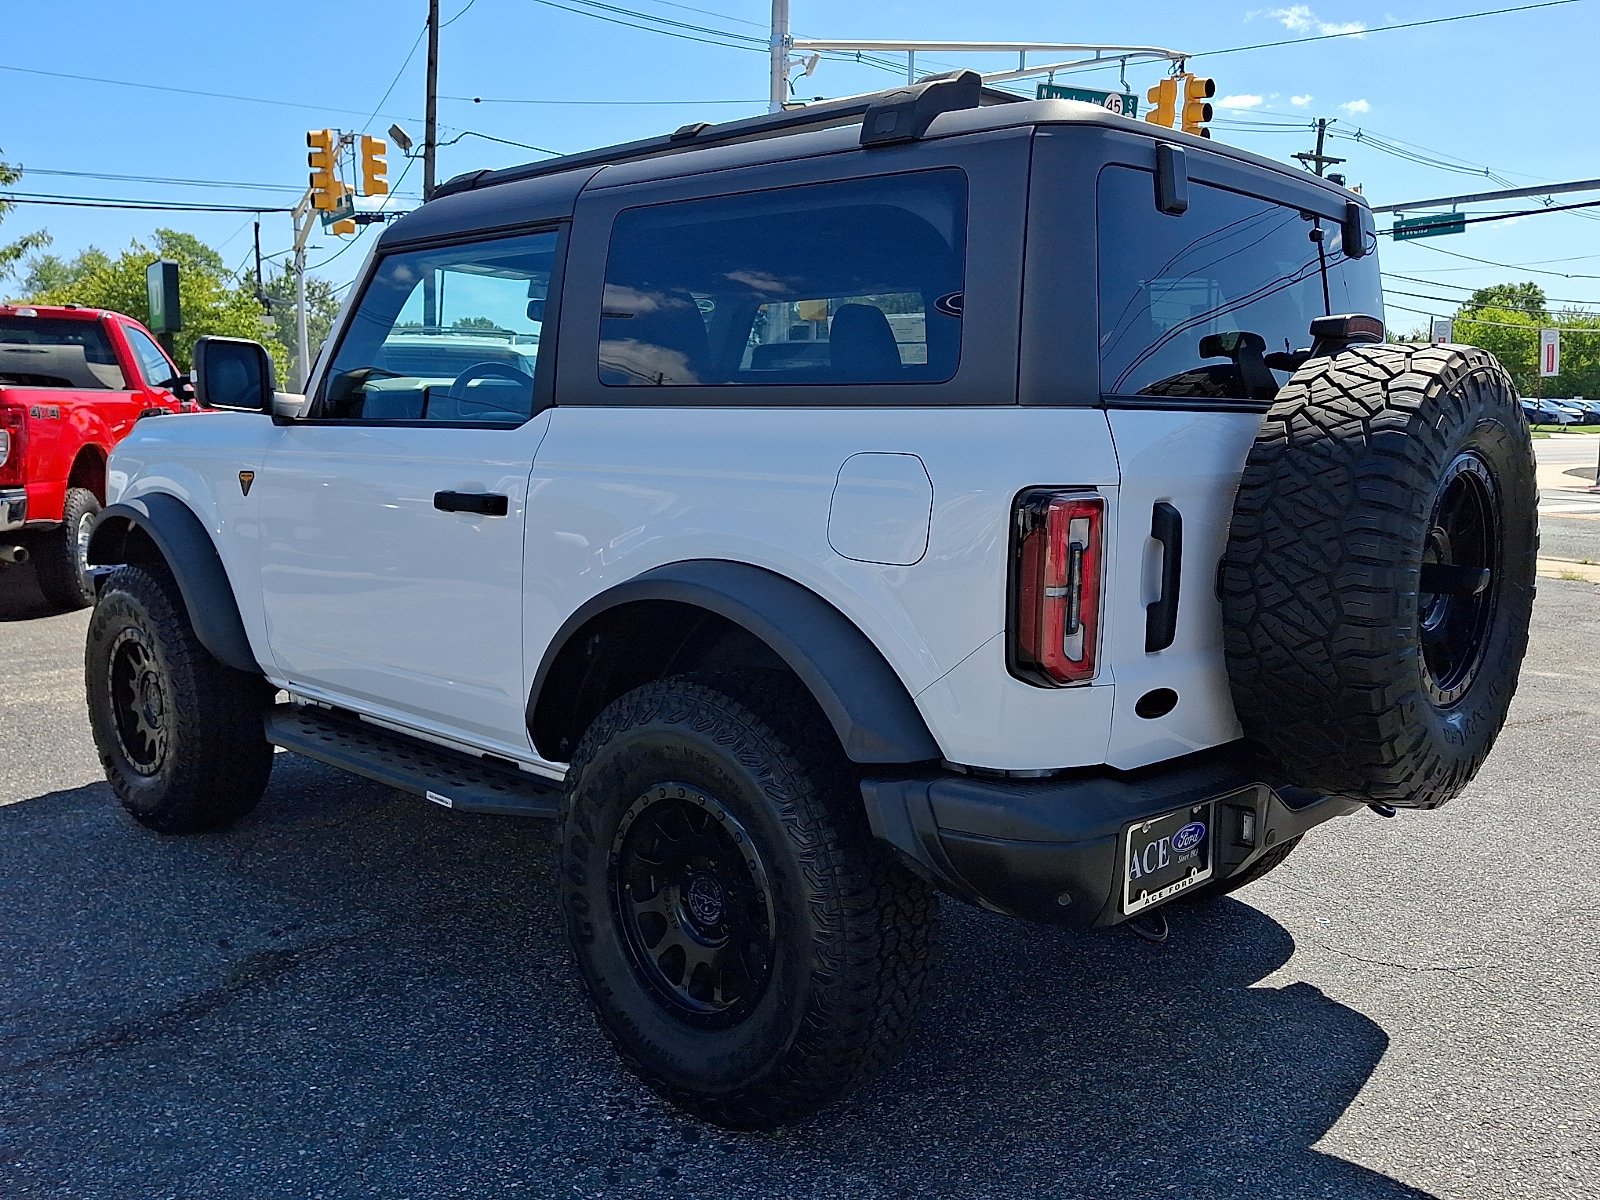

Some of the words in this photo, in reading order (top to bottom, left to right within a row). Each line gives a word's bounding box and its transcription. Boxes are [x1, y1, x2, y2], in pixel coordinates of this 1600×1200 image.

[1041, 88, 1048, 99] N
[1106, 99, 1120, 114] 45
[1128, 99, 1134, 110] S
[1129, 836, 1171, 880] ACE
[1144, 892, 1164, 905] ACE
[1168, 877, 1194, 894] FORD
